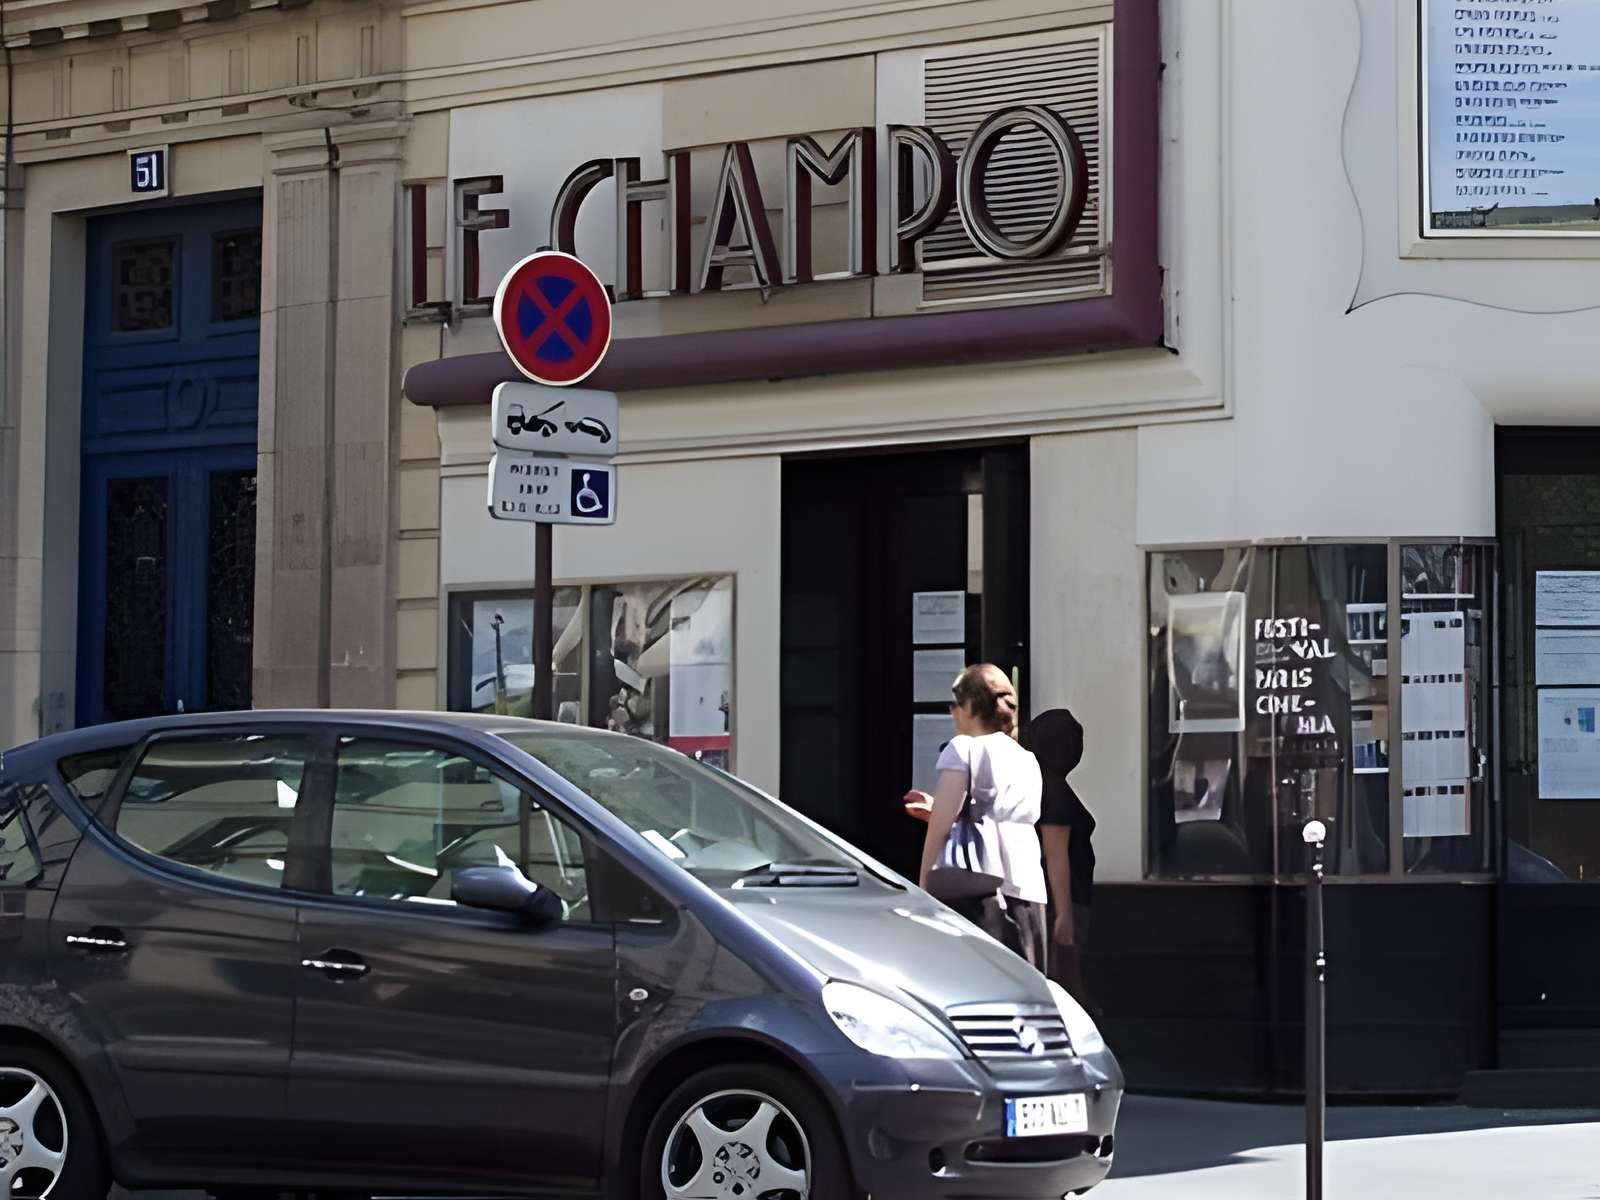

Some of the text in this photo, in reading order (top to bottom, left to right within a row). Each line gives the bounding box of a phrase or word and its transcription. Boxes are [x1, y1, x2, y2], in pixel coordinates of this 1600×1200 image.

[135, 153, 158, 188] 51
[402, 105, 1090, 322] LE CHAMPO
